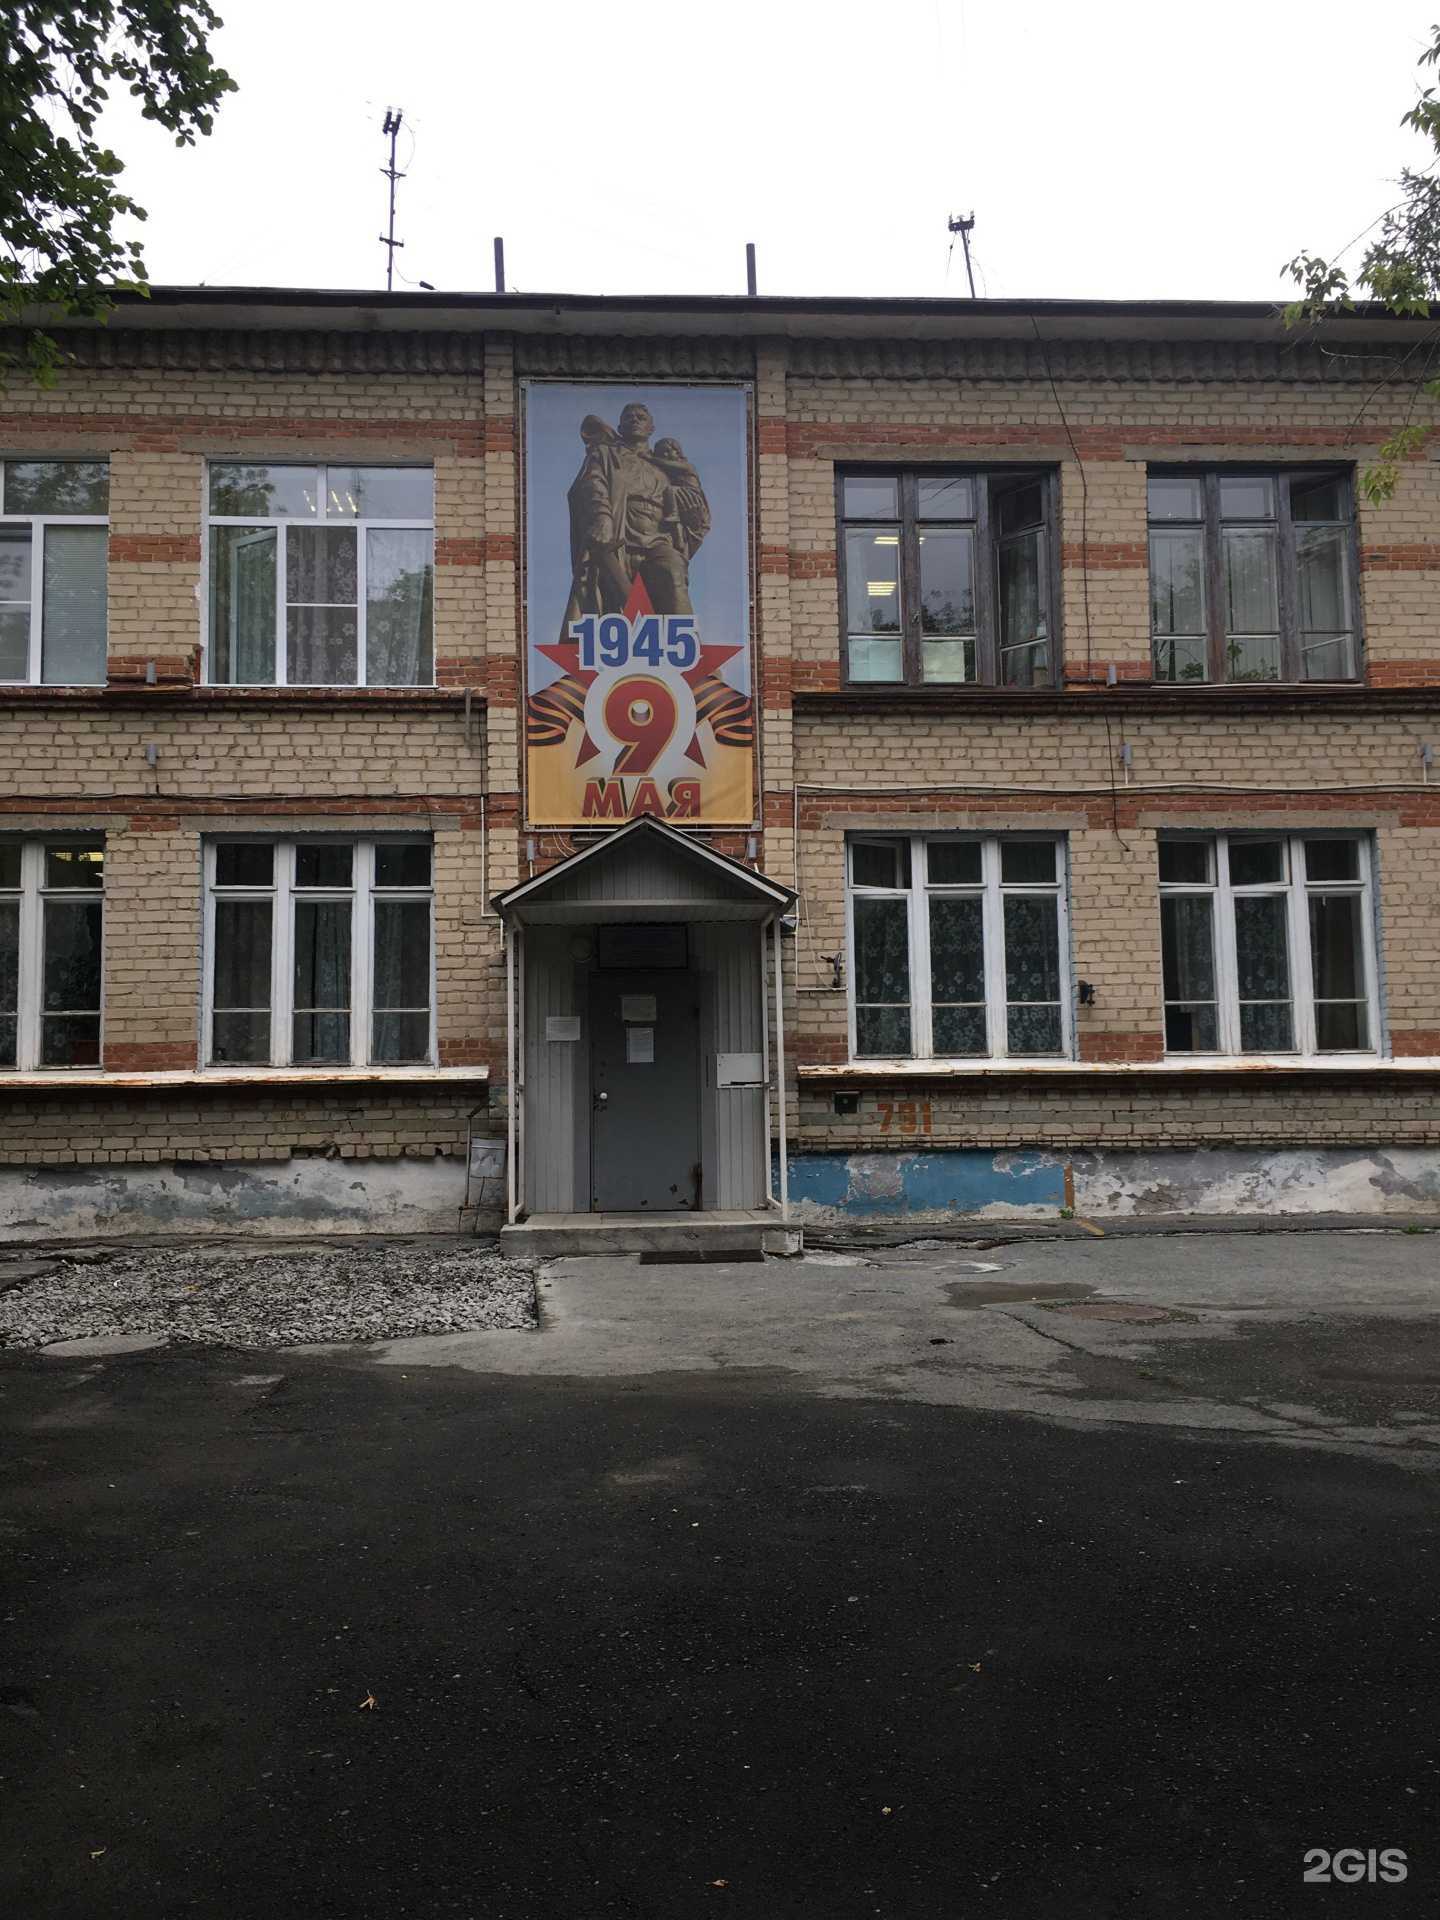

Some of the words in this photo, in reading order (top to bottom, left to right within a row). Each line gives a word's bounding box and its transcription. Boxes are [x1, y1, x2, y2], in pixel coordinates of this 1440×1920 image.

[573, 617, 697, 668] 1945
[602, 673, 679, 777] 9
[581, 777, 702, 818] МАЯ
